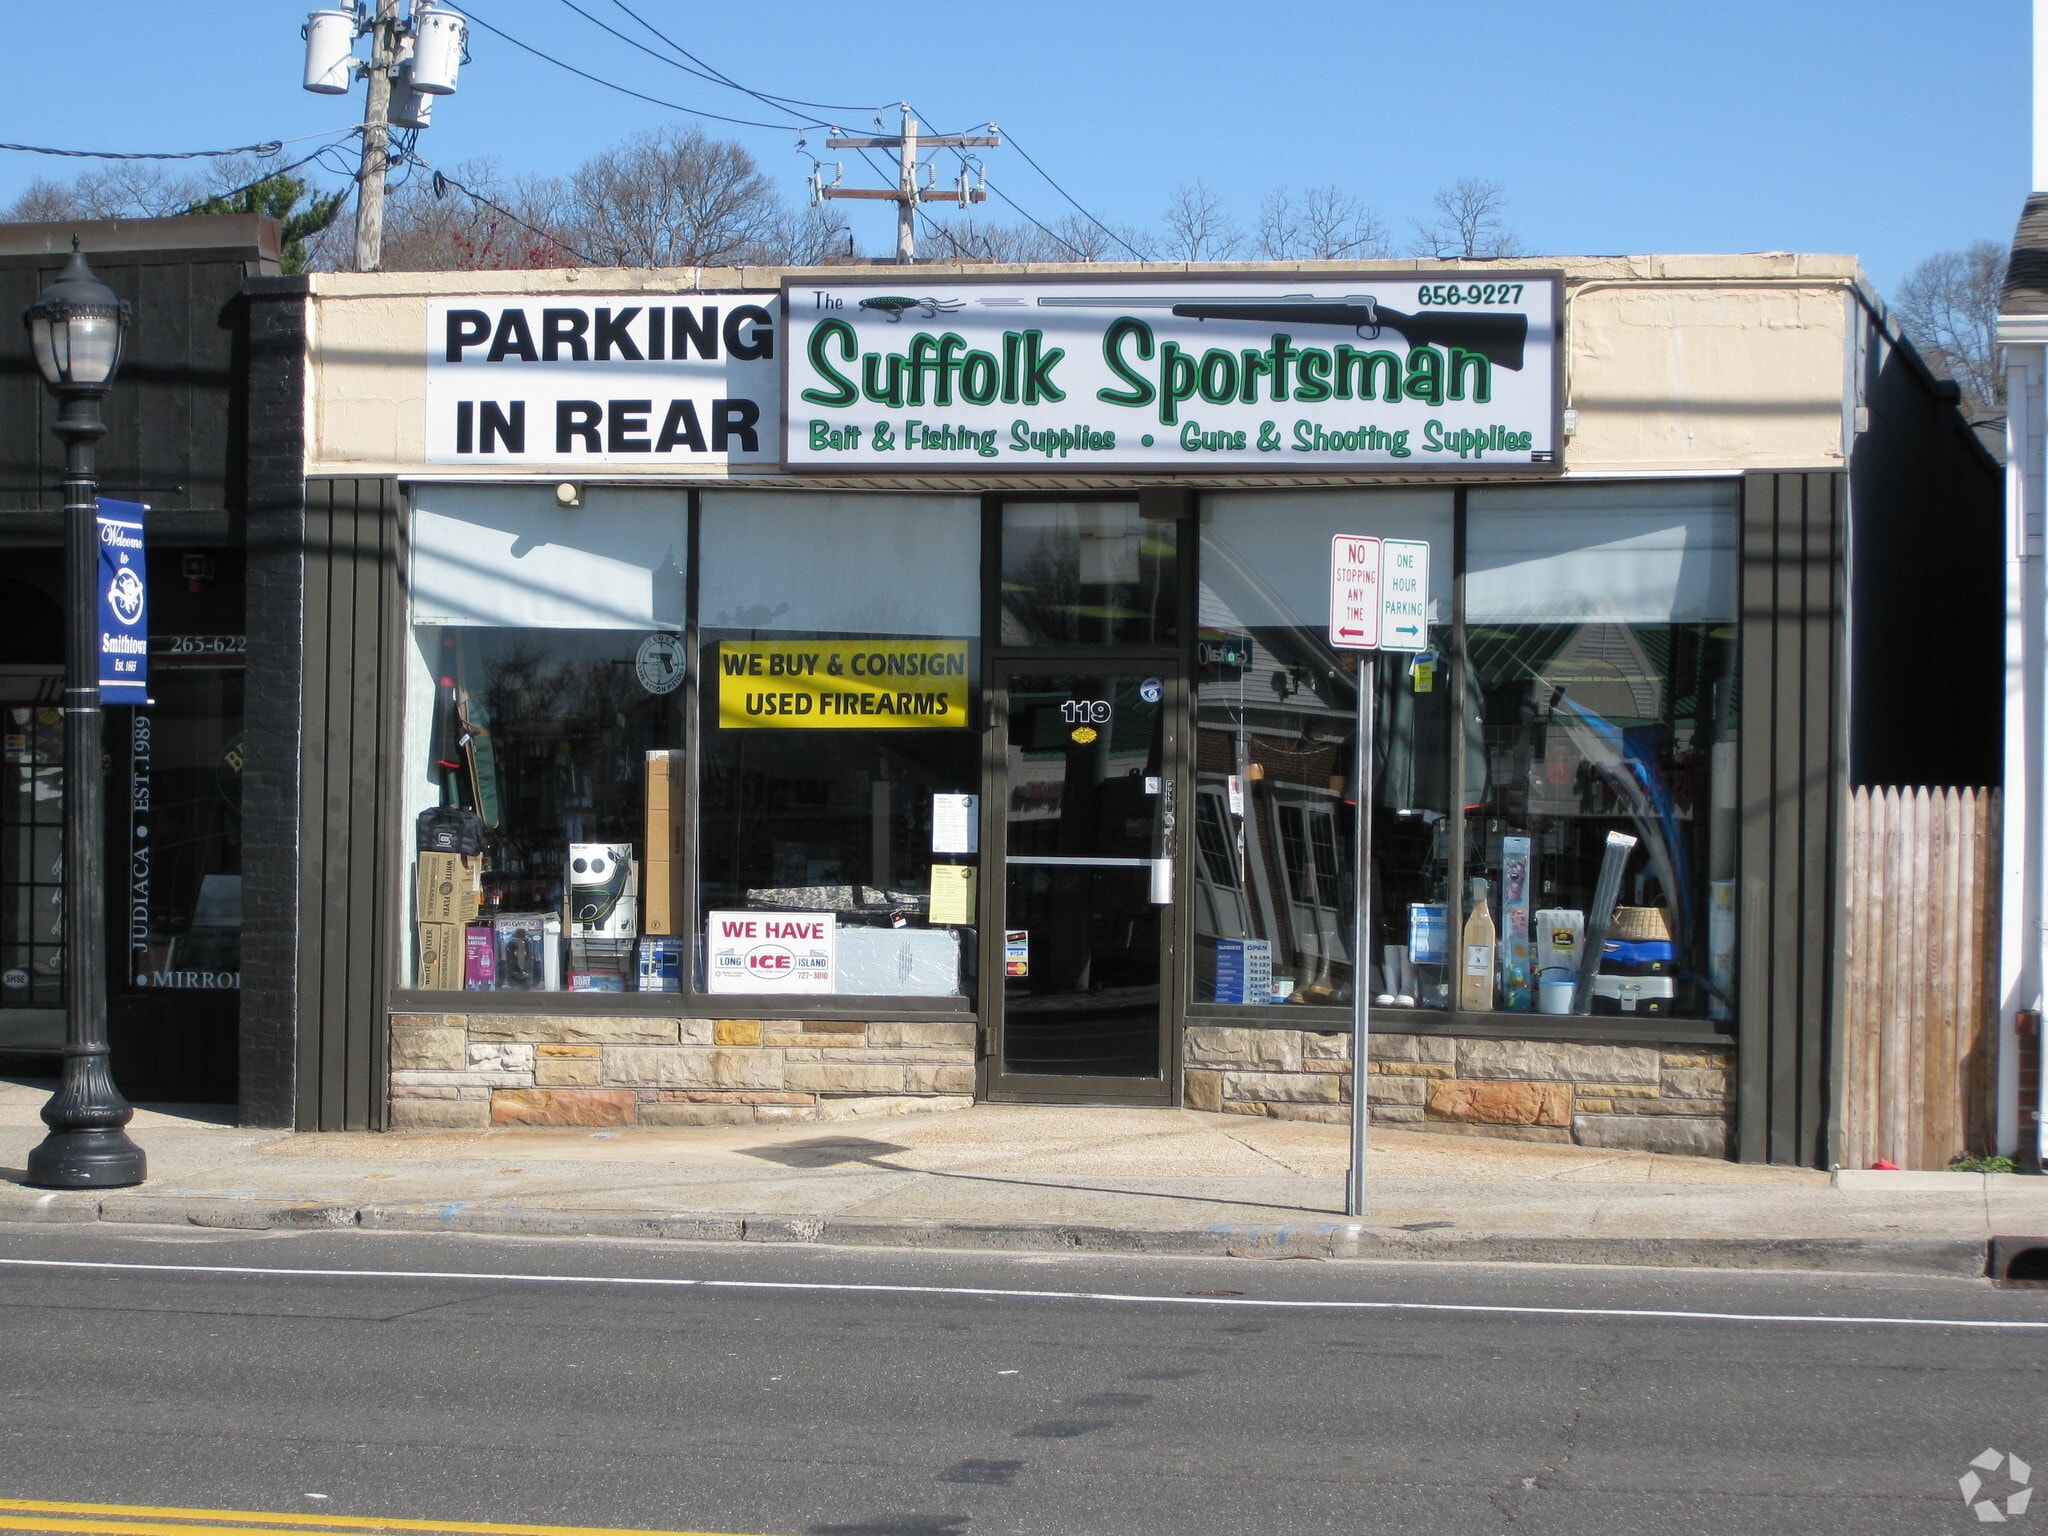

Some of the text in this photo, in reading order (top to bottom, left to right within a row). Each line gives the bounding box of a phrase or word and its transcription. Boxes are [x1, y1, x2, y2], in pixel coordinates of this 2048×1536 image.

[812, 290, 844, 310] The
[1417, 283, 1524, 306] 656-9227
[446, 304, 774, 363] PARKING
[800, 316, 1492, 426] Suffolk Sportsman
[456, 398, 760, 454] IN REAR
[808, 419, 1116, 458] Bait & Fishing Supplies
[1179, 419, 1533, 459] Guns & Shooting Supplies
[101, 523, 143, 550] Welcome
[119, 551, 130, 565] to
[1347, 543, 1366, 565] NO
[1396, 553, 1414, 569] ONE
[1336, 567, 1376, 584] STOPPING
[1392, 577, 1417, 592] HOUR
[1347, 588, 1364, 602] ANY
[1346, 606, 1364, 621] TIME
[1385, 600, 1423, 616] PARKING
[102, 632, 148, 655] Smithtown
[646, 635, 676, 646] GLOCK
[722, 653, 964, 677] WE BUY & CONSIGN
[745, 692, 949, 716] USED FIREARMS
[1060, 700, 1112, 724] 119
[442, 860, 453, 917] WHITE FLYER
[132, 846, 149, 953] JUDIACA
[425, 929, 433, 950] FLYER
[721, 921, 825, 940] WE HAVE
[719, 954, 827, 969] LONG ICE ISLAND
[5, 973, 26, 984] SHSE
[152, 970, 241, 989] MIRRO
[797, 971, 829, 980] 727-3010
